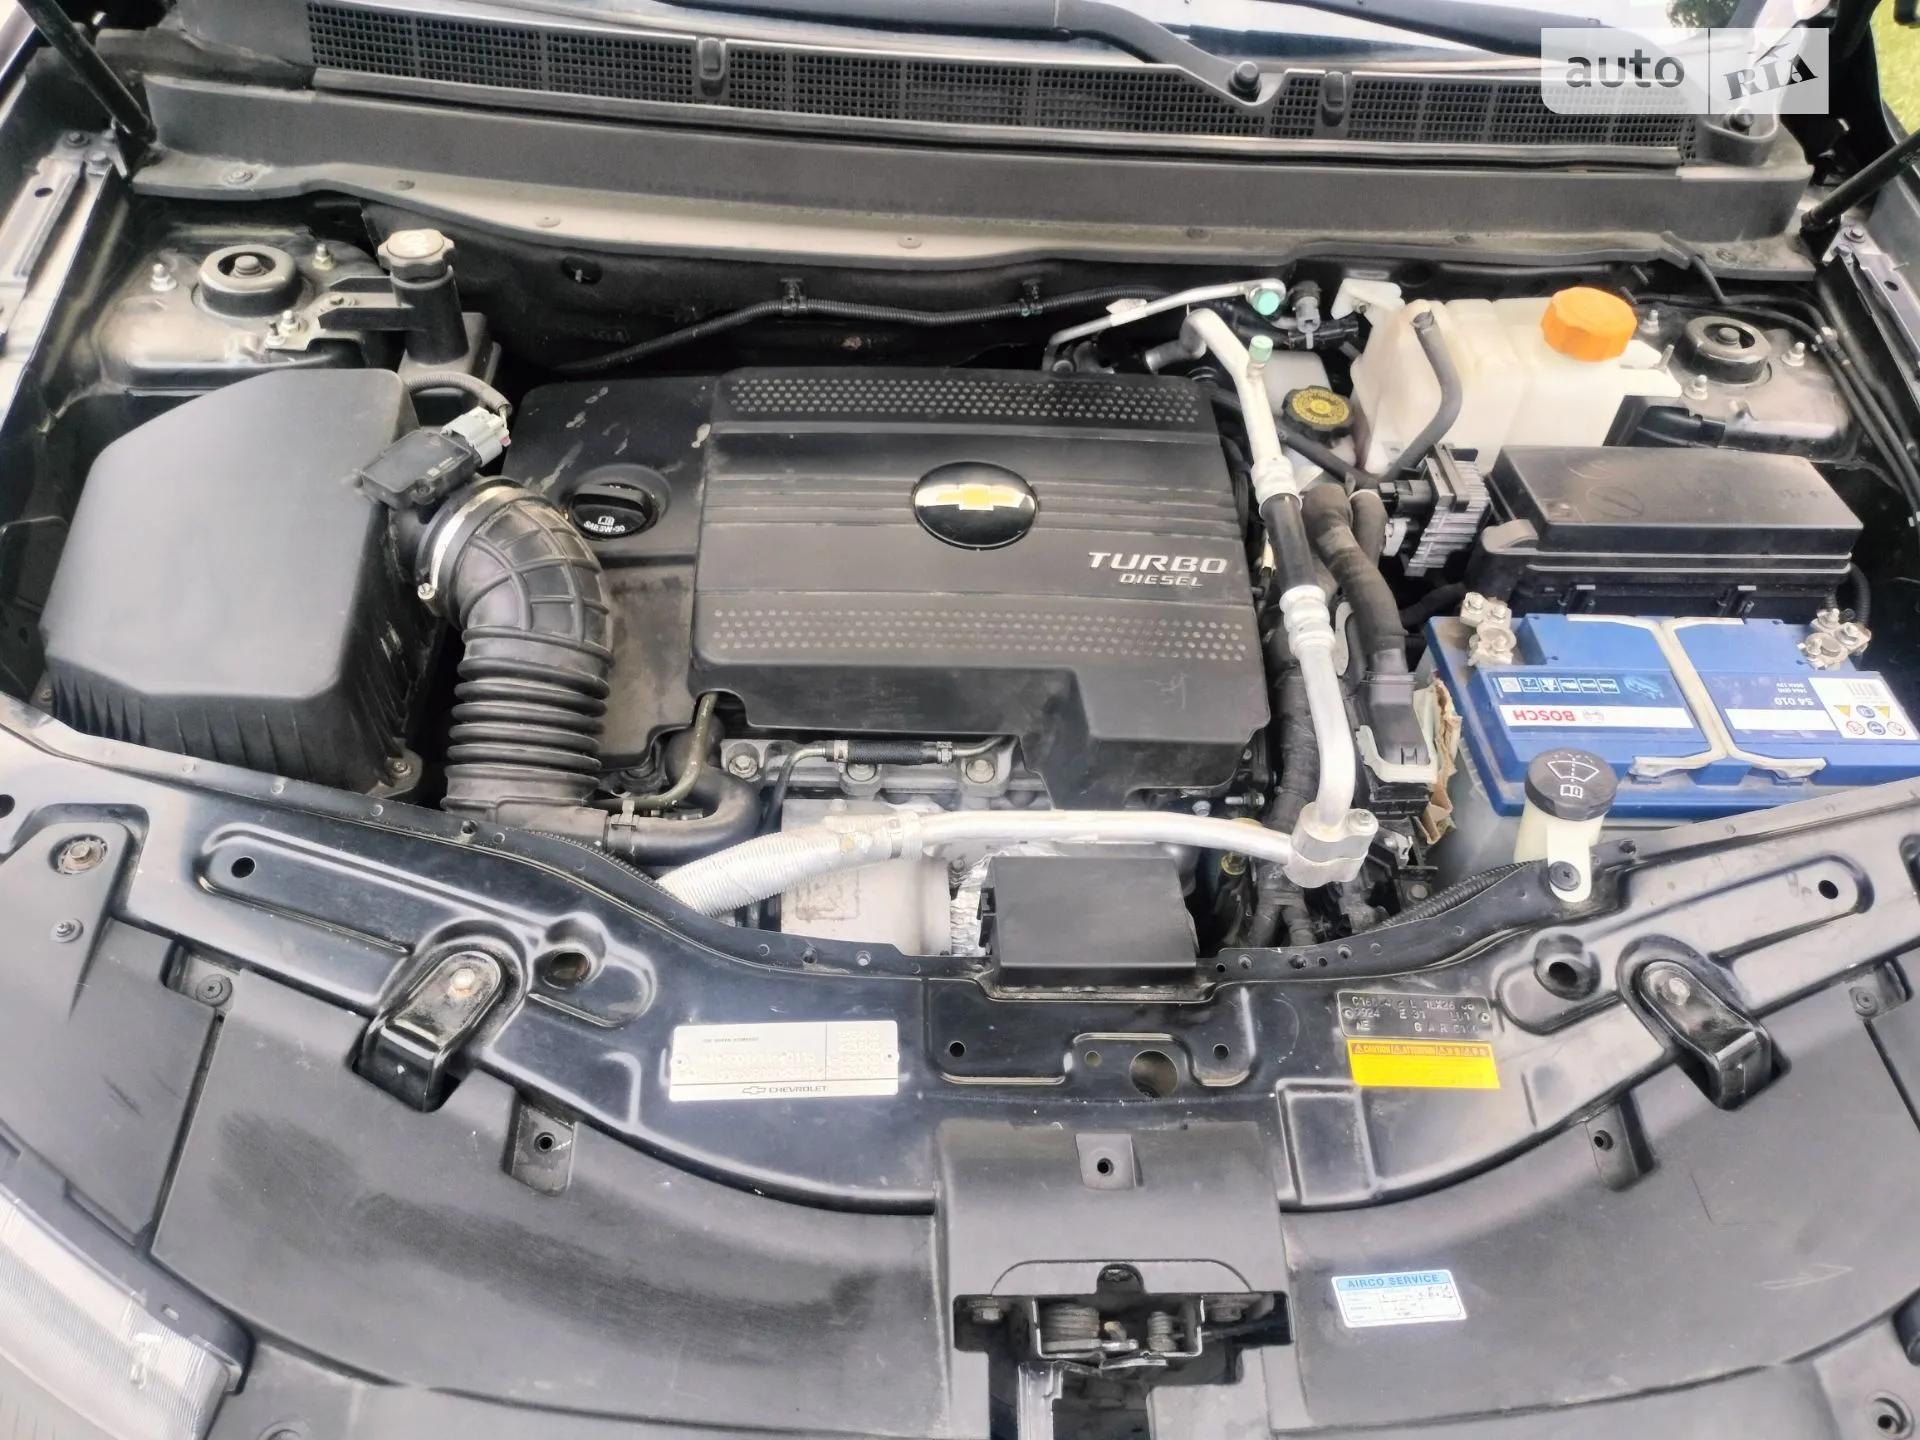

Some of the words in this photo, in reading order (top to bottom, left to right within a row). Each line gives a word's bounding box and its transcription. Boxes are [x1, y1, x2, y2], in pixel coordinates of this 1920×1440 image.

[1089, 552, 1228, 573] TURBO
[1120, 574, 1203, 586] DIESEL
[1775, 697, 1796, 706] 010
[1798, 697, 1815, 706] S4
[1512, 709, 1577, 721] BOSCH
[768, 1085, 827, 1093] CHEVROLET
[1348, 1278, 1384, 1288] AIRCO
[1388, 1274, 1440, 1286] SERVICE
